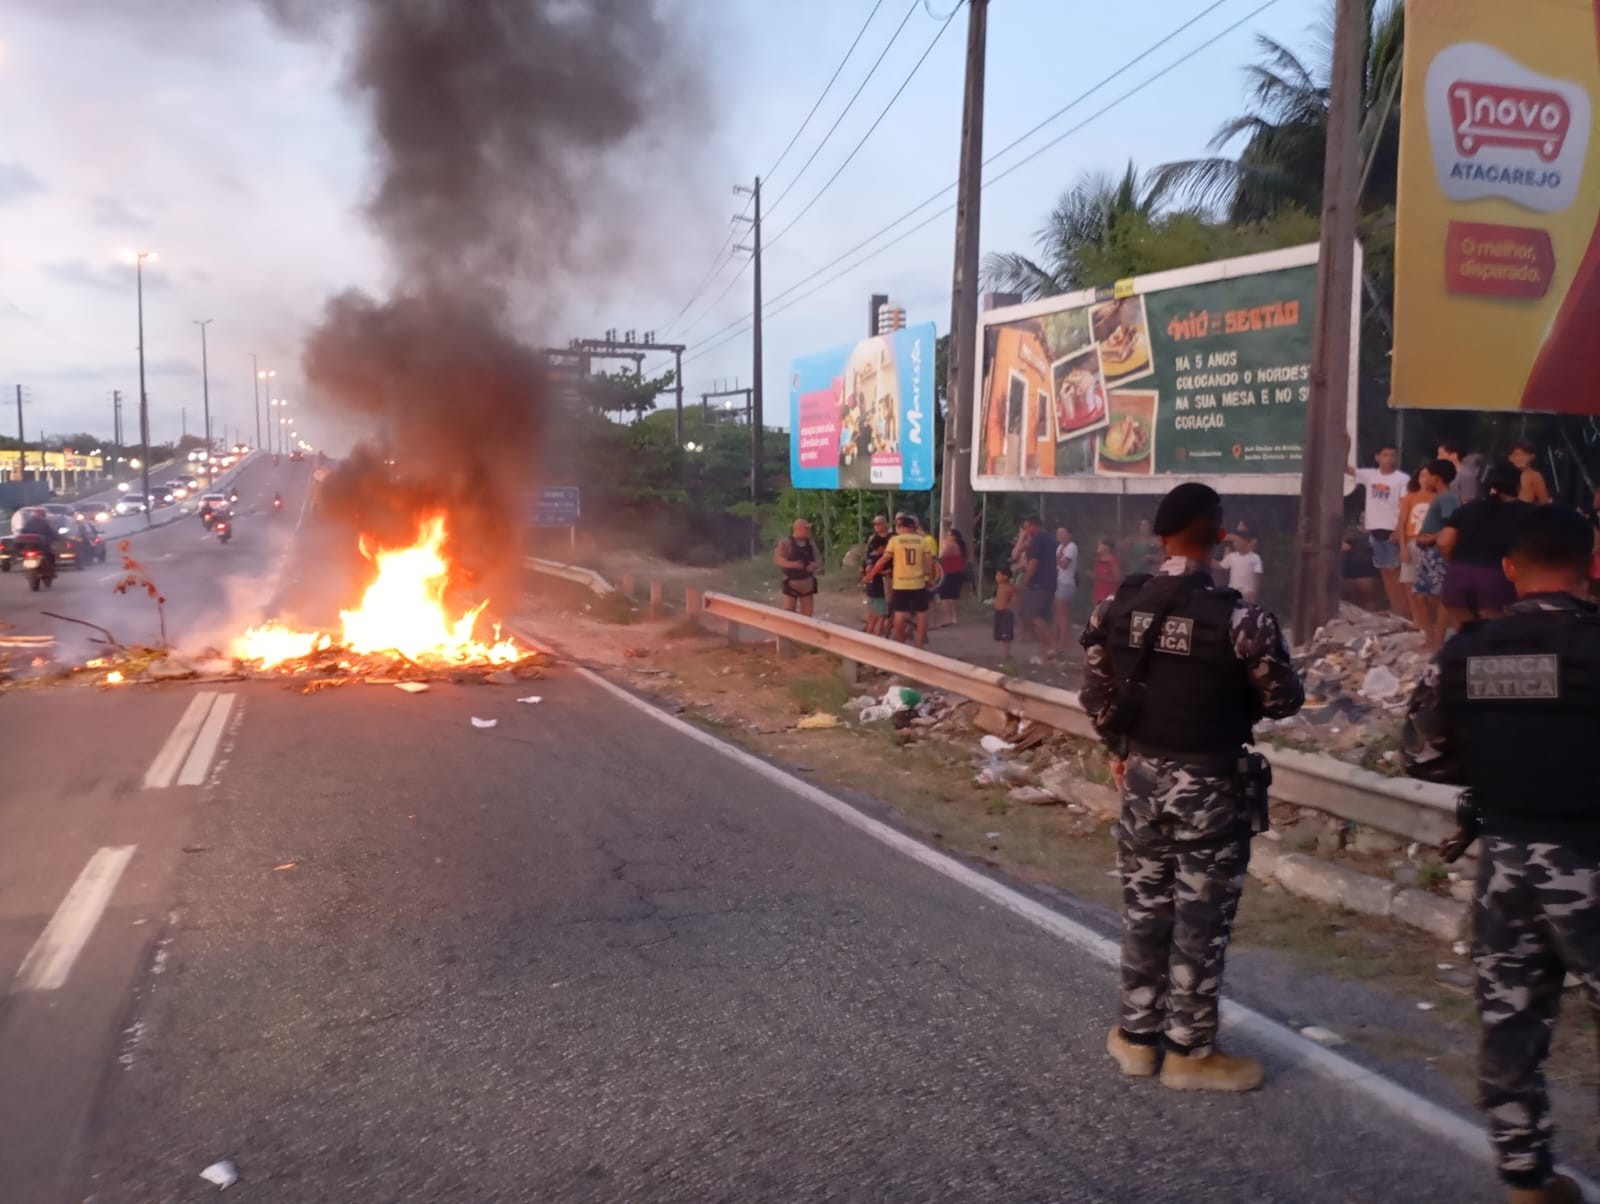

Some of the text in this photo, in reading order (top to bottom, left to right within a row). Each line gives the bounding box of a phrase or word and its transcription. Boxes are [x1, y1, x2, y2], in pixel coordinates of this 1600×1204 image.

[1450, 163, 1561, 189] ATACAREJO
[1195, 353, 1203, 369] 5
[1208, 351, 1238, 368] ANOS
[1176, 372, 1239, 390] COLOCANDO
[1244, 370, 1252, 385] O
[1175, 395, 1190, 410] NA
[1195, 394, 1217, 408] SUA
[1222, 390, 1256, 407] MESA
[1261, 388, 1269, 404] E
[1275, 387, 1292, 403] NO
[904, 548, 917, 567] 10
[1133, 615, 1189, 636] FOÇA
[1132, 632, 1188, 651] TICA
